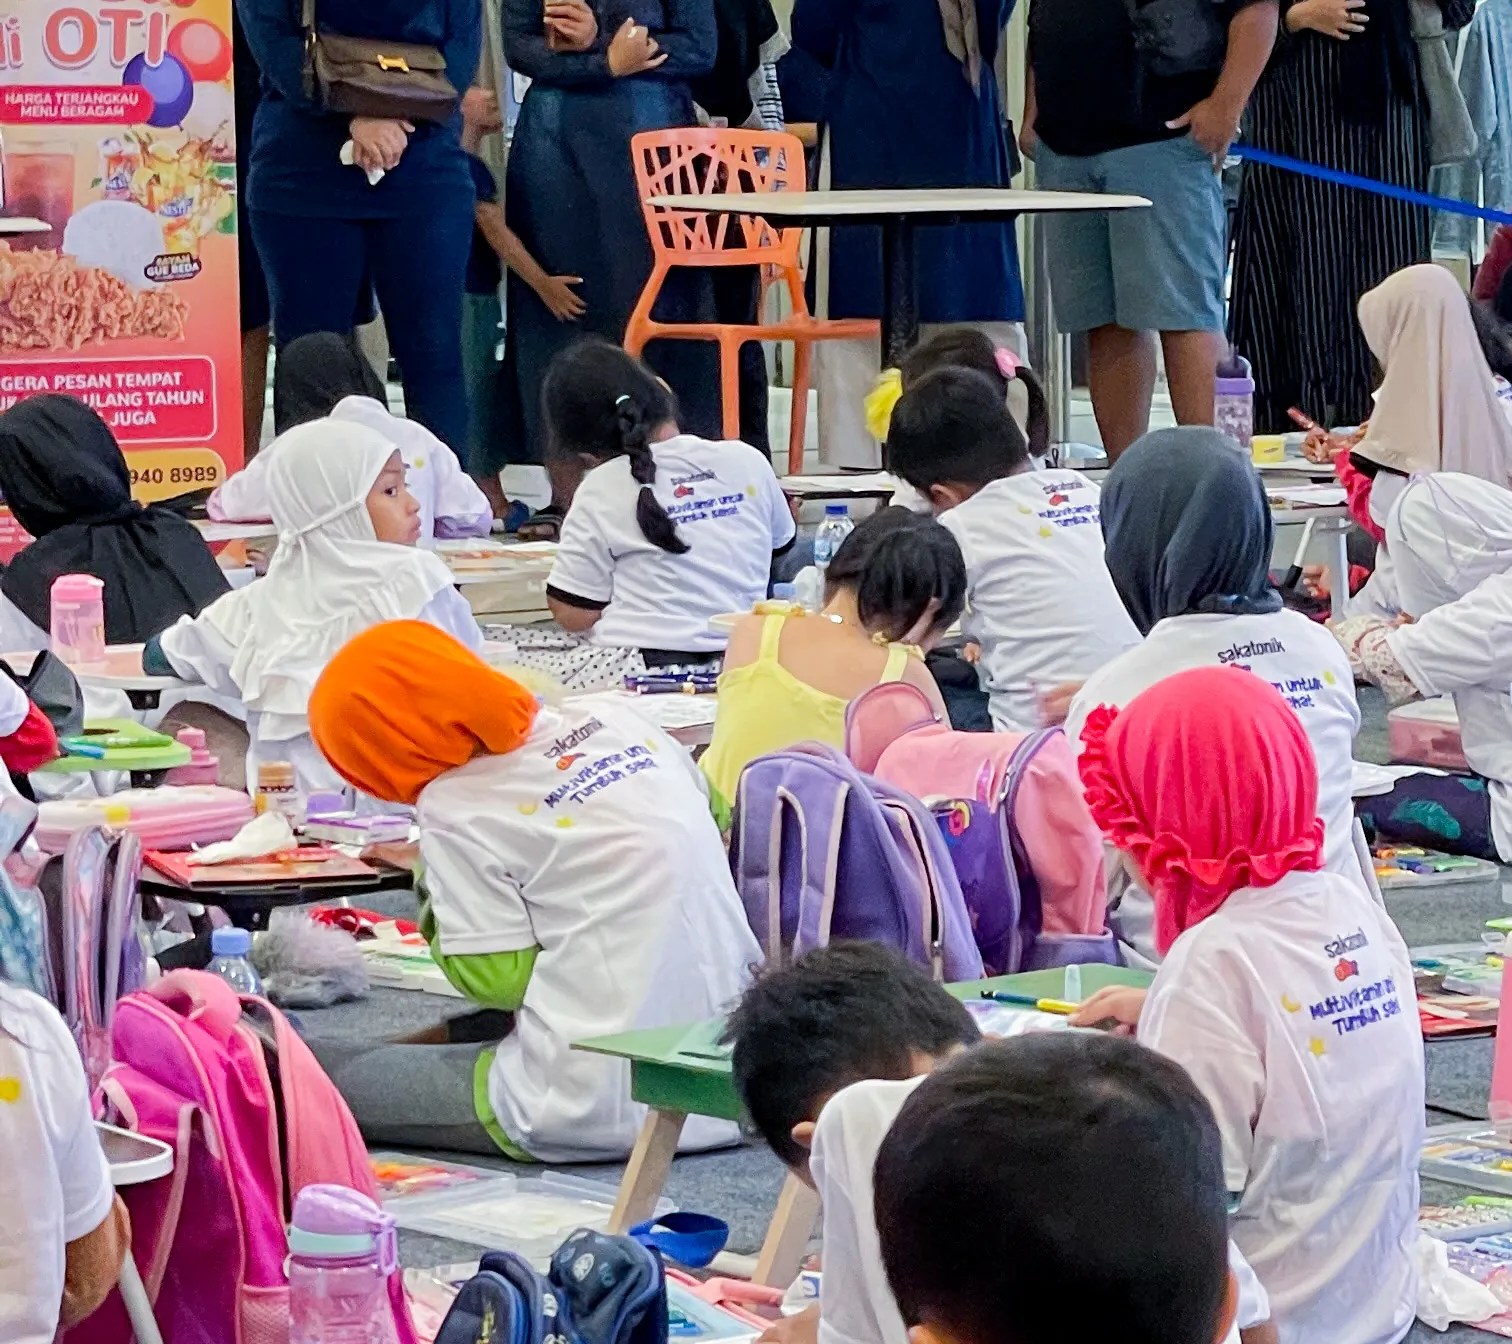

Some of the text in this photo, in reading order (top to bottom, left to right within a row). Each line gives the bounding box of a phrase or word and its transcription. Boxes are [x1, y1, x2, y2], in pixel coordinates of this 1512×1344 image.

[43, 7, 168, 72] OTI
[5, 91, 53, 106] HARGA
[20, 105, 58, 118] MENU
[54, 374, 112, 390] PESAN
[114, 372, 183, 386] TEMPAT
[145, 389, 204, 405] TAHUN
[110, 411, 156, 427] JUGA
[169, 466, 217, 483] 8989
[1218, 637, 1285, 663] sakatonik
